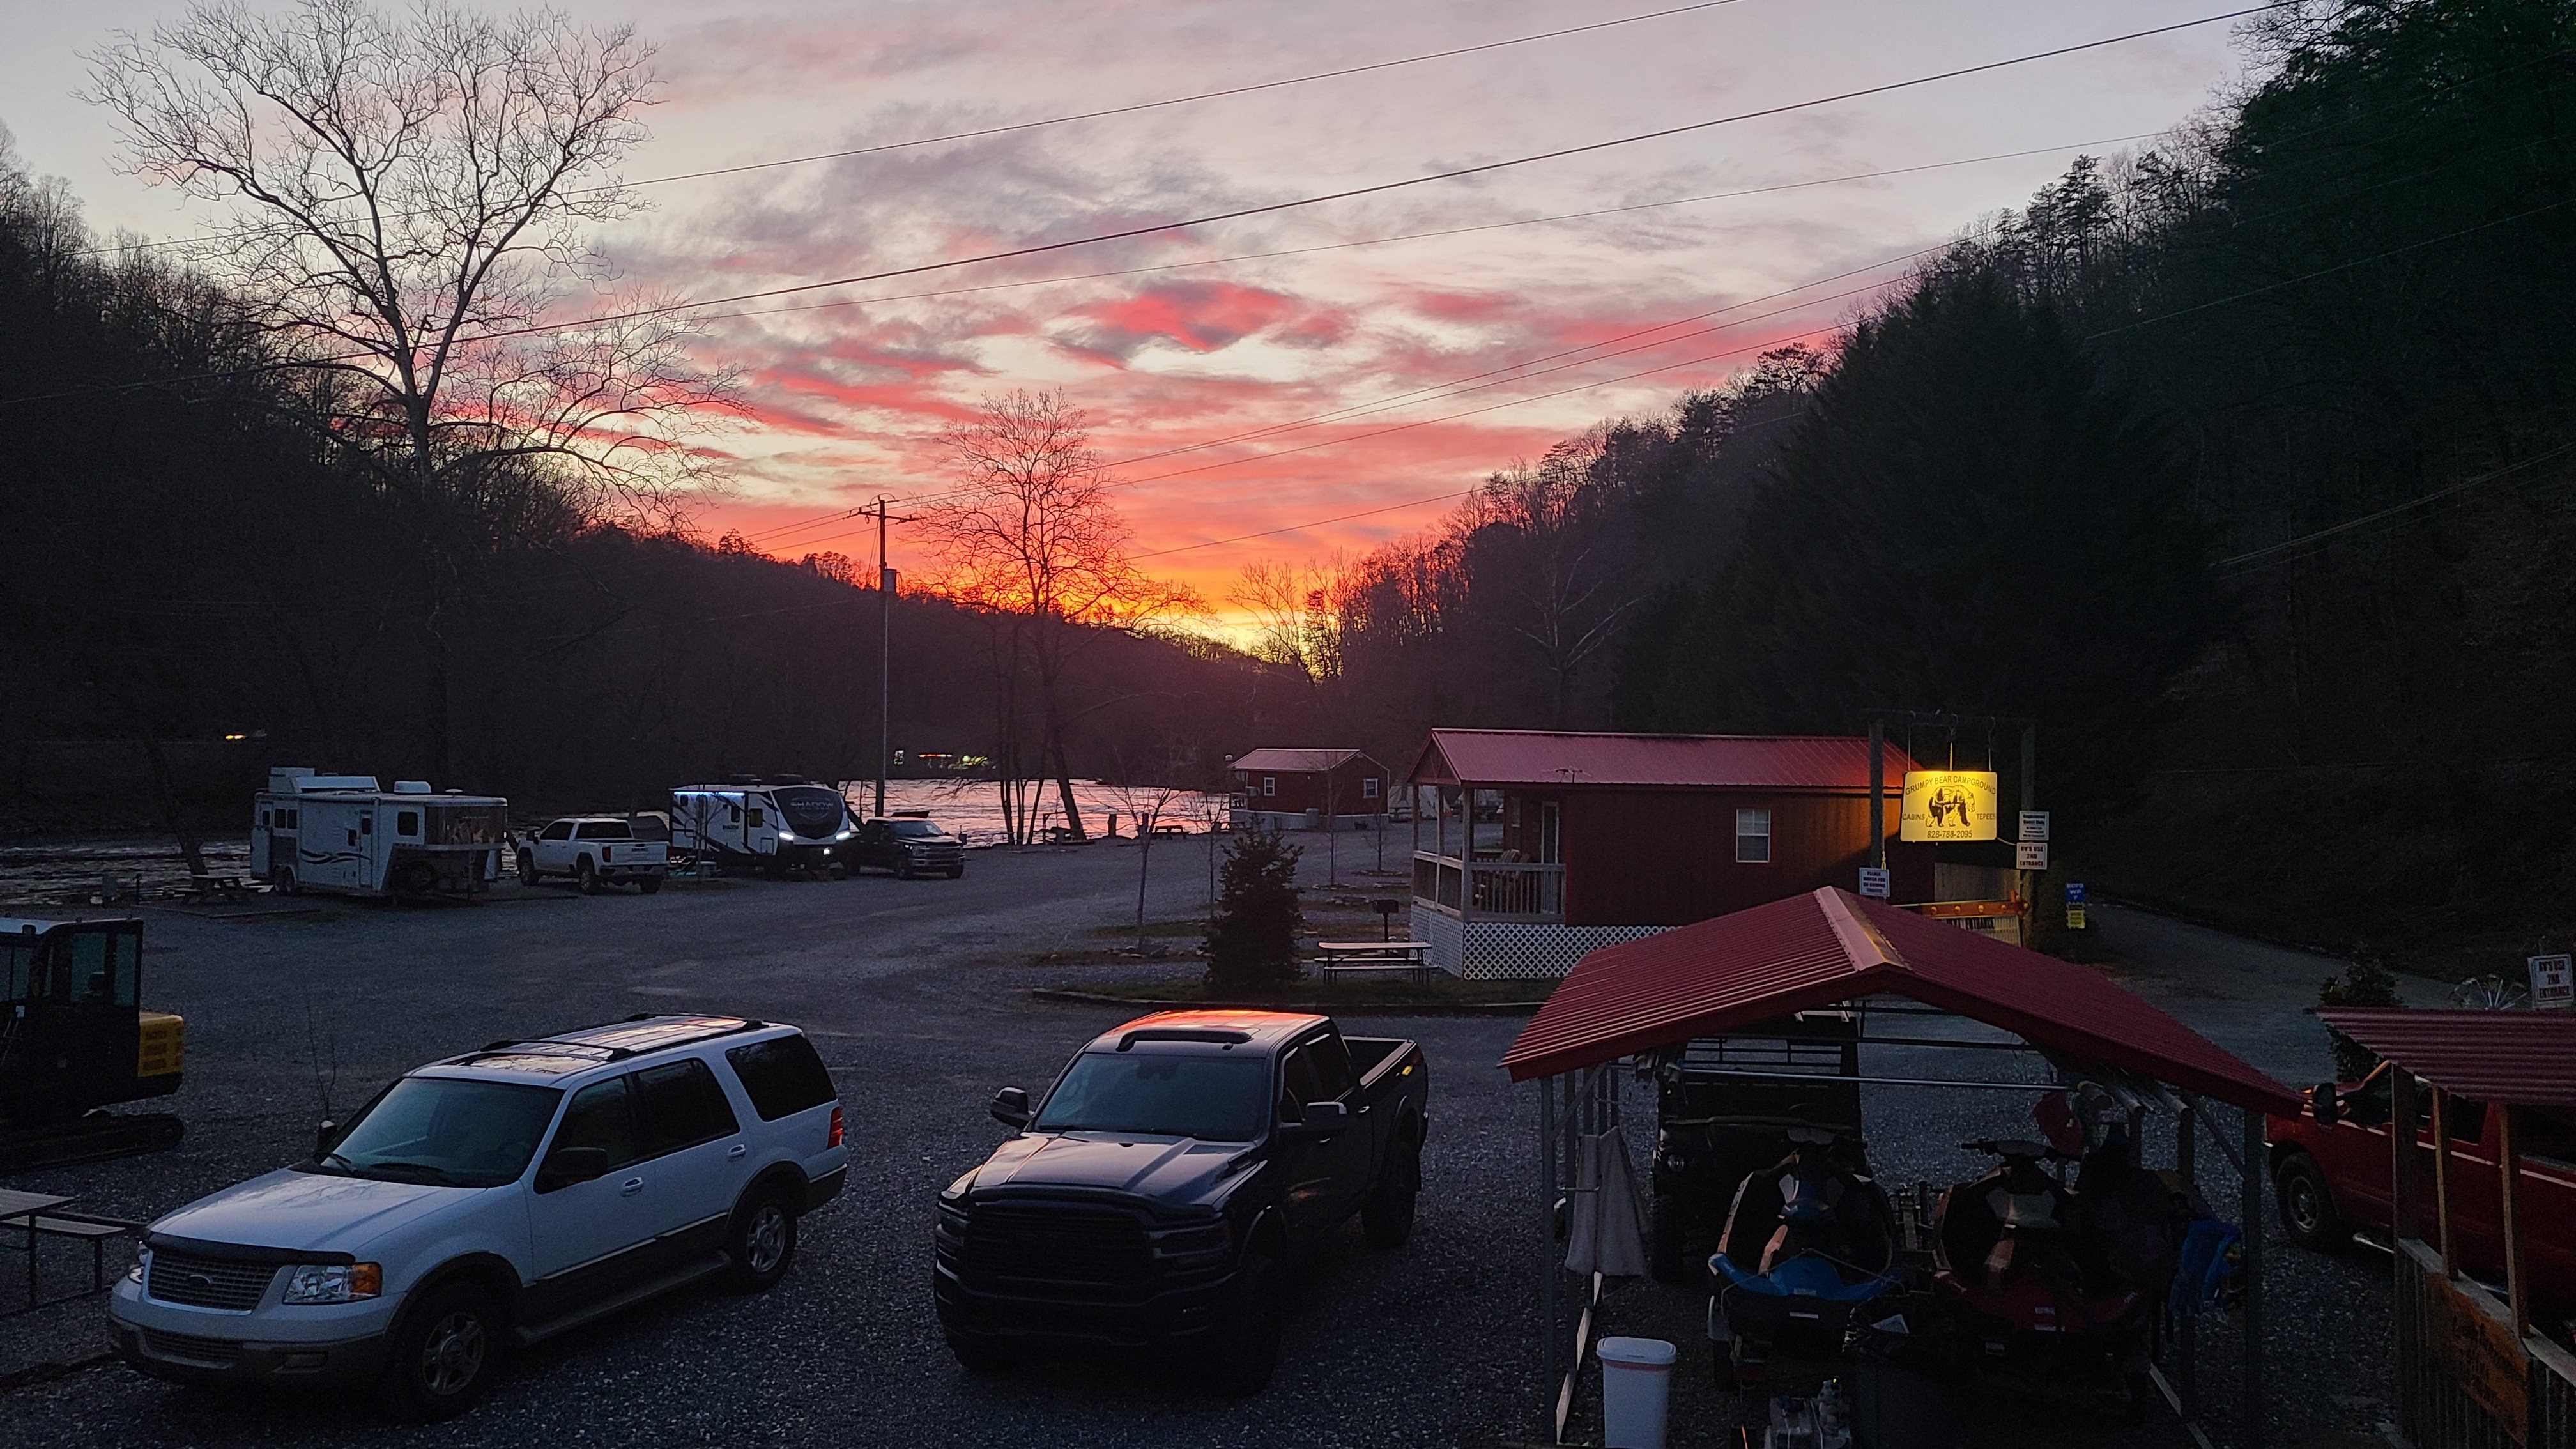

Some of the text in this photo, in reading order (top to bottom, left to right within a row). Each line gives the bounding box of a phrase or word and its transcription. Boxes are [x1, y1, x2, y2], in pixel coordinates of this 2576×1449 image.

[1905, 775, 1996, 795] GRUMPY BEAR CAMPGROUND
[1927, 830, 1972, 839] 828-788-2095
[2539, 986, 2570, 998] ENTRANCE
